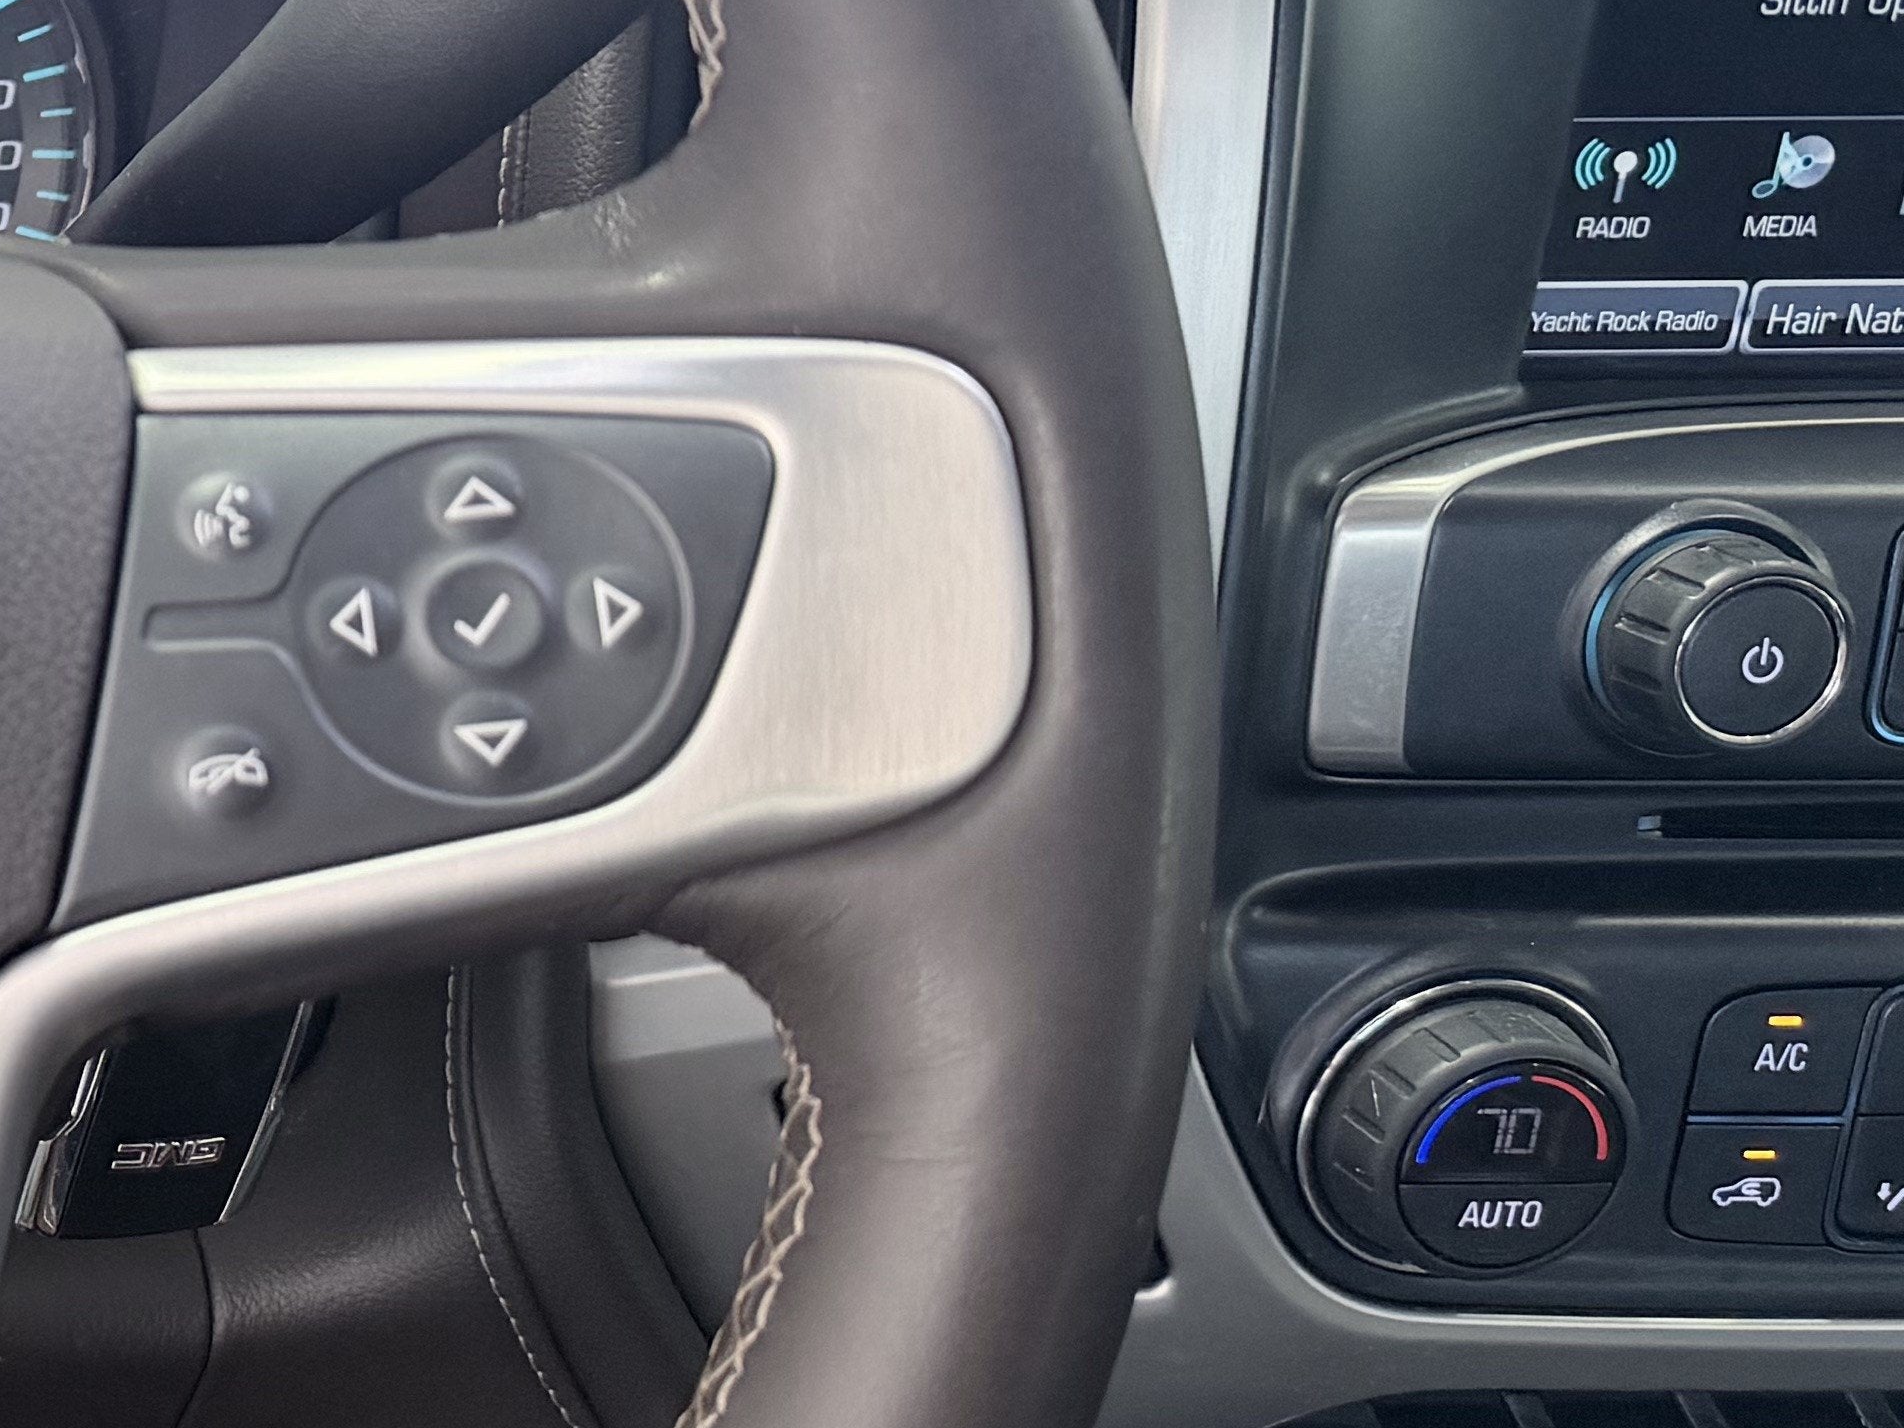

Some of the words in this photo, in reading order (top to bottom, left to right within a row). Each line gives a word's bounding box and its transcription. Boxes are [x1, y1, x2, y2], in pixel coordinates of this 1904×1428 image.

[1576, 216, 1651, 239] RADIO
[1742, 215, 1817, 238] MEDIA
[1531, 310, 1593, 332] Yacht
[1596, 310, 1650, 332] Rock
[1655, 309, 1718, 331] Radio
[1766, 304, 1836, 334] Hair
[1845, 303, 1904, 334] Nat
[1754, 1042, 1809, 1072] A/C
[111, 1136, 226, 1170] GMC
[1458, 1200, 1543, 1229] AUTO
